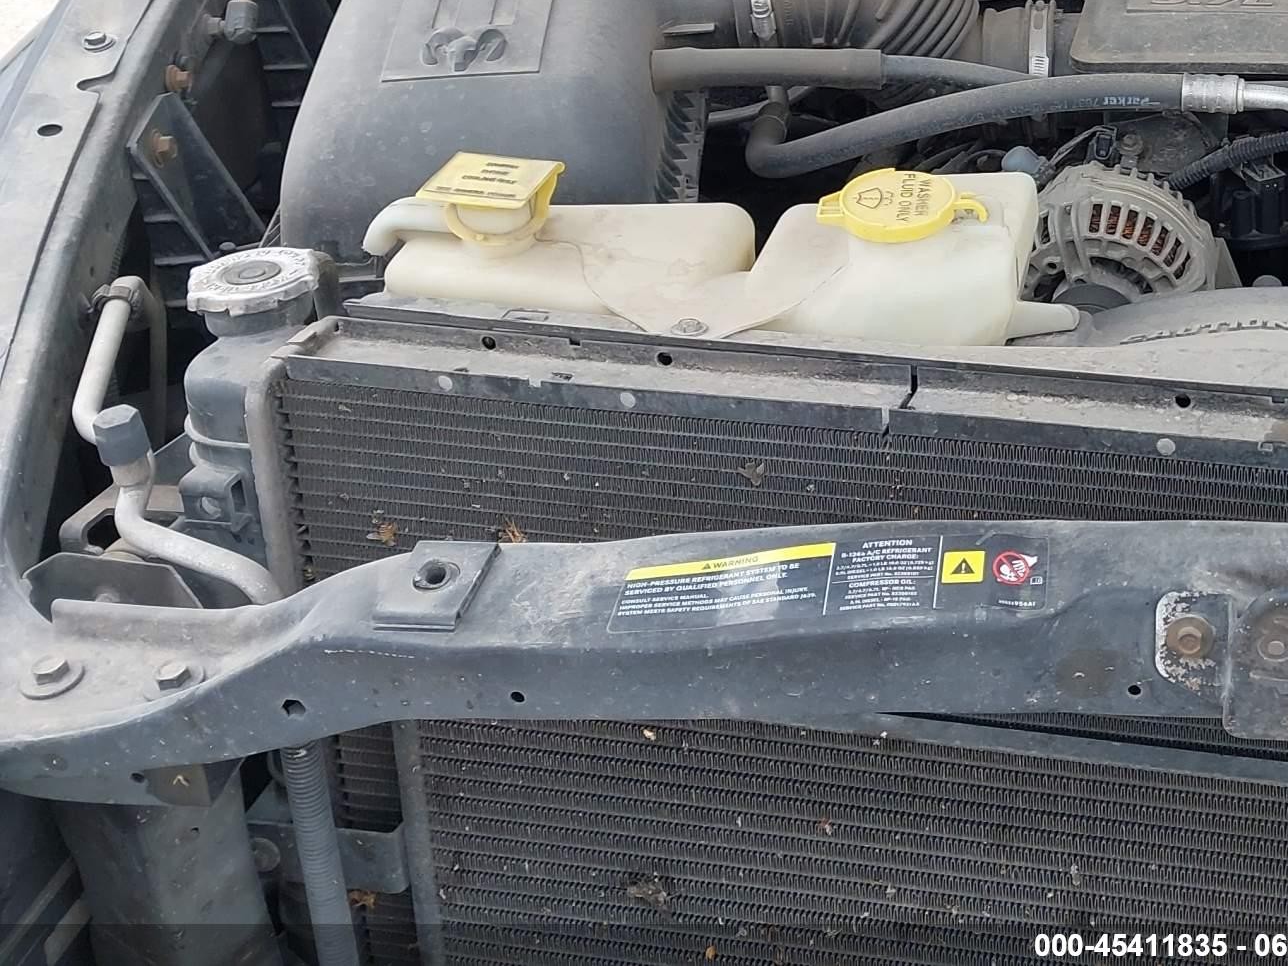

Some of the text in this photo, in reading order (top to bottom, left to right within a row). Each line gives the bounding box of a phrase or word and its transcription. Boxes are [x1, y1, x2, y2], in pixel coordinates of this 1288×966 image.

[1102, 96, 1151, 108] Parker
[896, 173, 916, 222] FLUID ONLY
[912, 178, 931, 216] WASHER
[862, 539, 913, 549] ATTENTION
[881, 547, 932, 555] REFRIGERANT
[714, 556, 760, 569] WARNING
[852, 555, 885, 563] FACTORY
[627, 577, 691, 588] HIGH-PRESSURE
[691, 570, 745, 583] REFRIGERANT
[745, 566, 777, 576] SYSTEM
[777, 564, 788, 572] TO
[624, 586, 664, 595] SERVICED
[664, 585, 675, 593] BY
[676, 582, 718, 591] QUALIFIED
[719, 576, 765, 587] PERSONNEL
[848, 579, 900, 588] COMPRESSOR
[750, 590, 784, 599] PERSONAL
[621, 597, 651, 605] CONSULT
[691, 601, 743, 611] REQUIREMENTS
[765, 594, 799, 602] STANDARD
